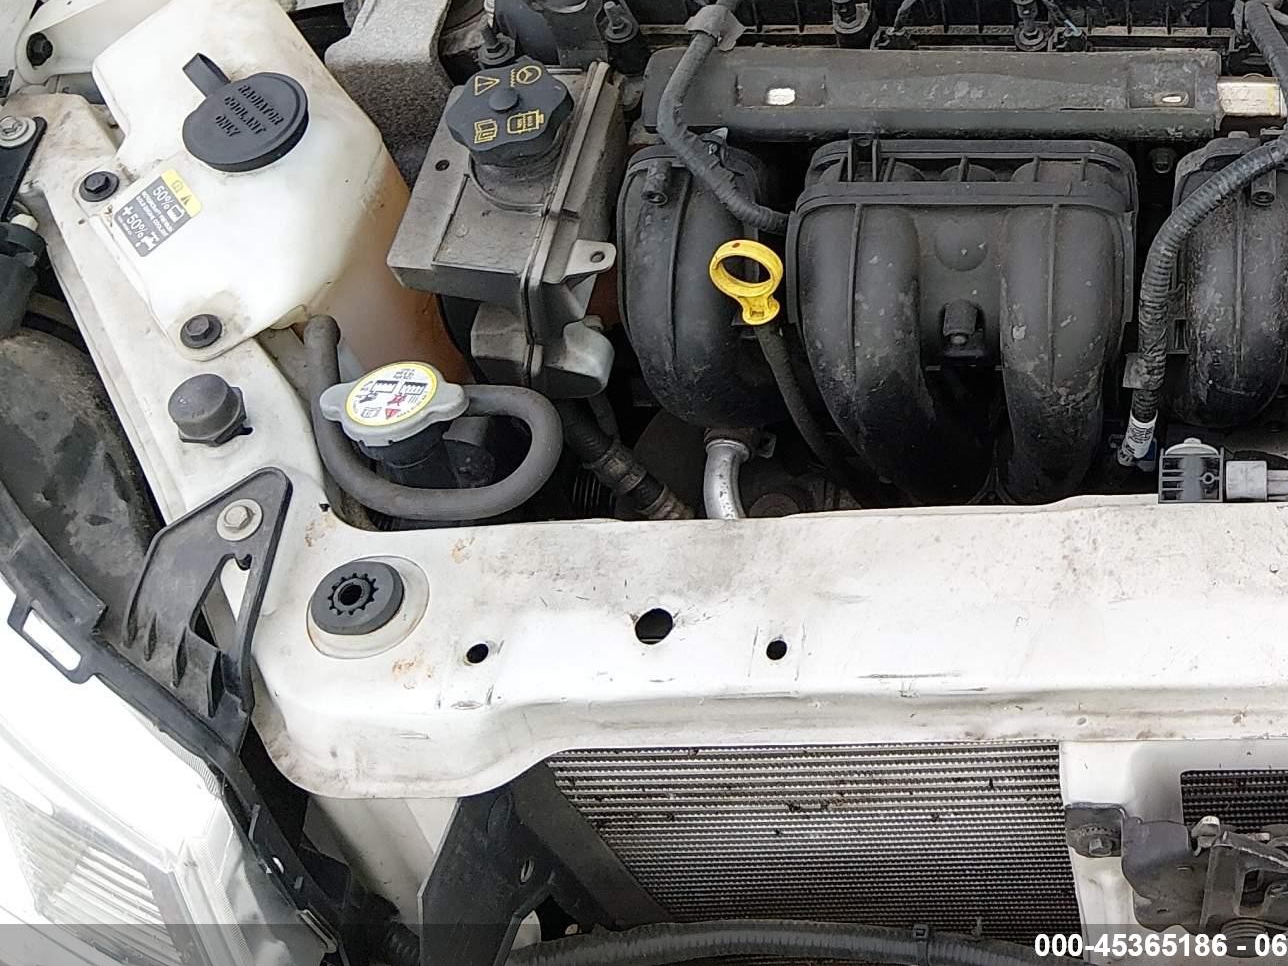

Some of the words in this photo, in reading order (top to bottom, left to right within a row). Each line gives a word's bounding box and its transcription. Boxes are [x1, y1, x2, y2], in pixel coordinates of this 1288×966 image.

[224, 95, 268, 135] COOLANT
[238, 84, 285, 126] RADIATOR
[214, 113, 242, 138] ONLY
[152, 185, 170, 210] 50%
